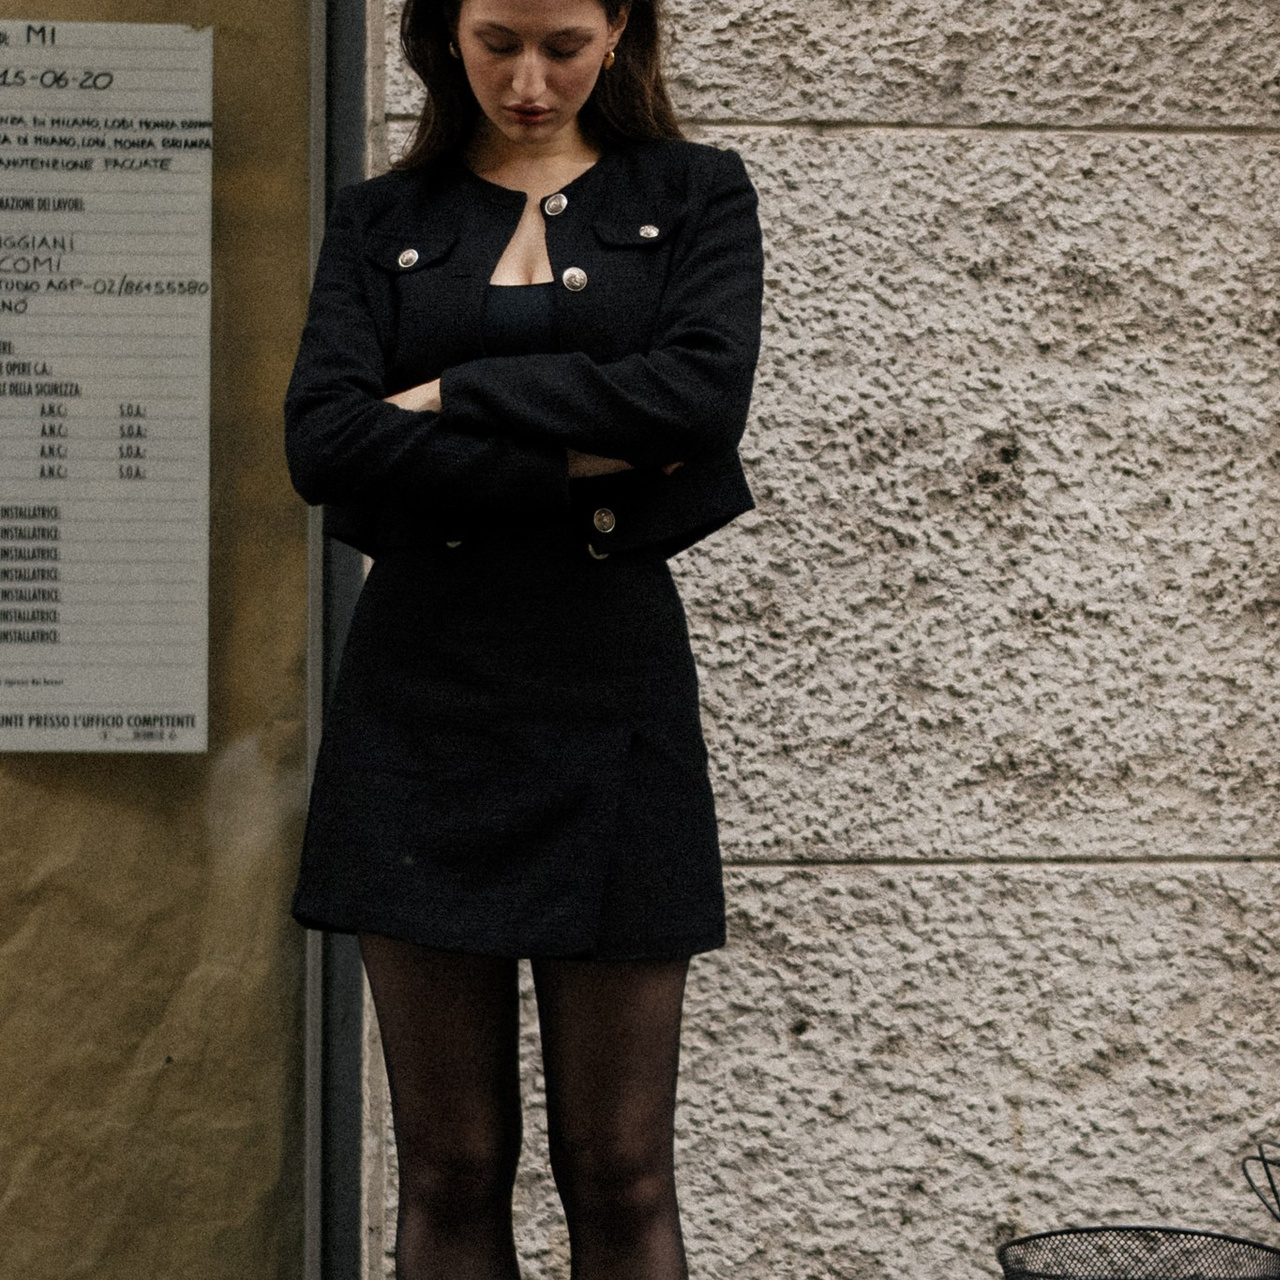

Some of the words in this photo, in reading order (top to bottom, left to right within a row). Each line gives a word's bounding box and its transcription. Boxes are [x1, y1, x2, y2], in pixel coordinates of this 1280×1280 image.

[26, 23, 57, 46] MI
[0, 232, 74, 252] GGIANI
[28, 714, 70, 729] PRESSO
[73, 714, 124, 729] L'UFFICIO
[127, 714, 196, 729] COMPETENTE
